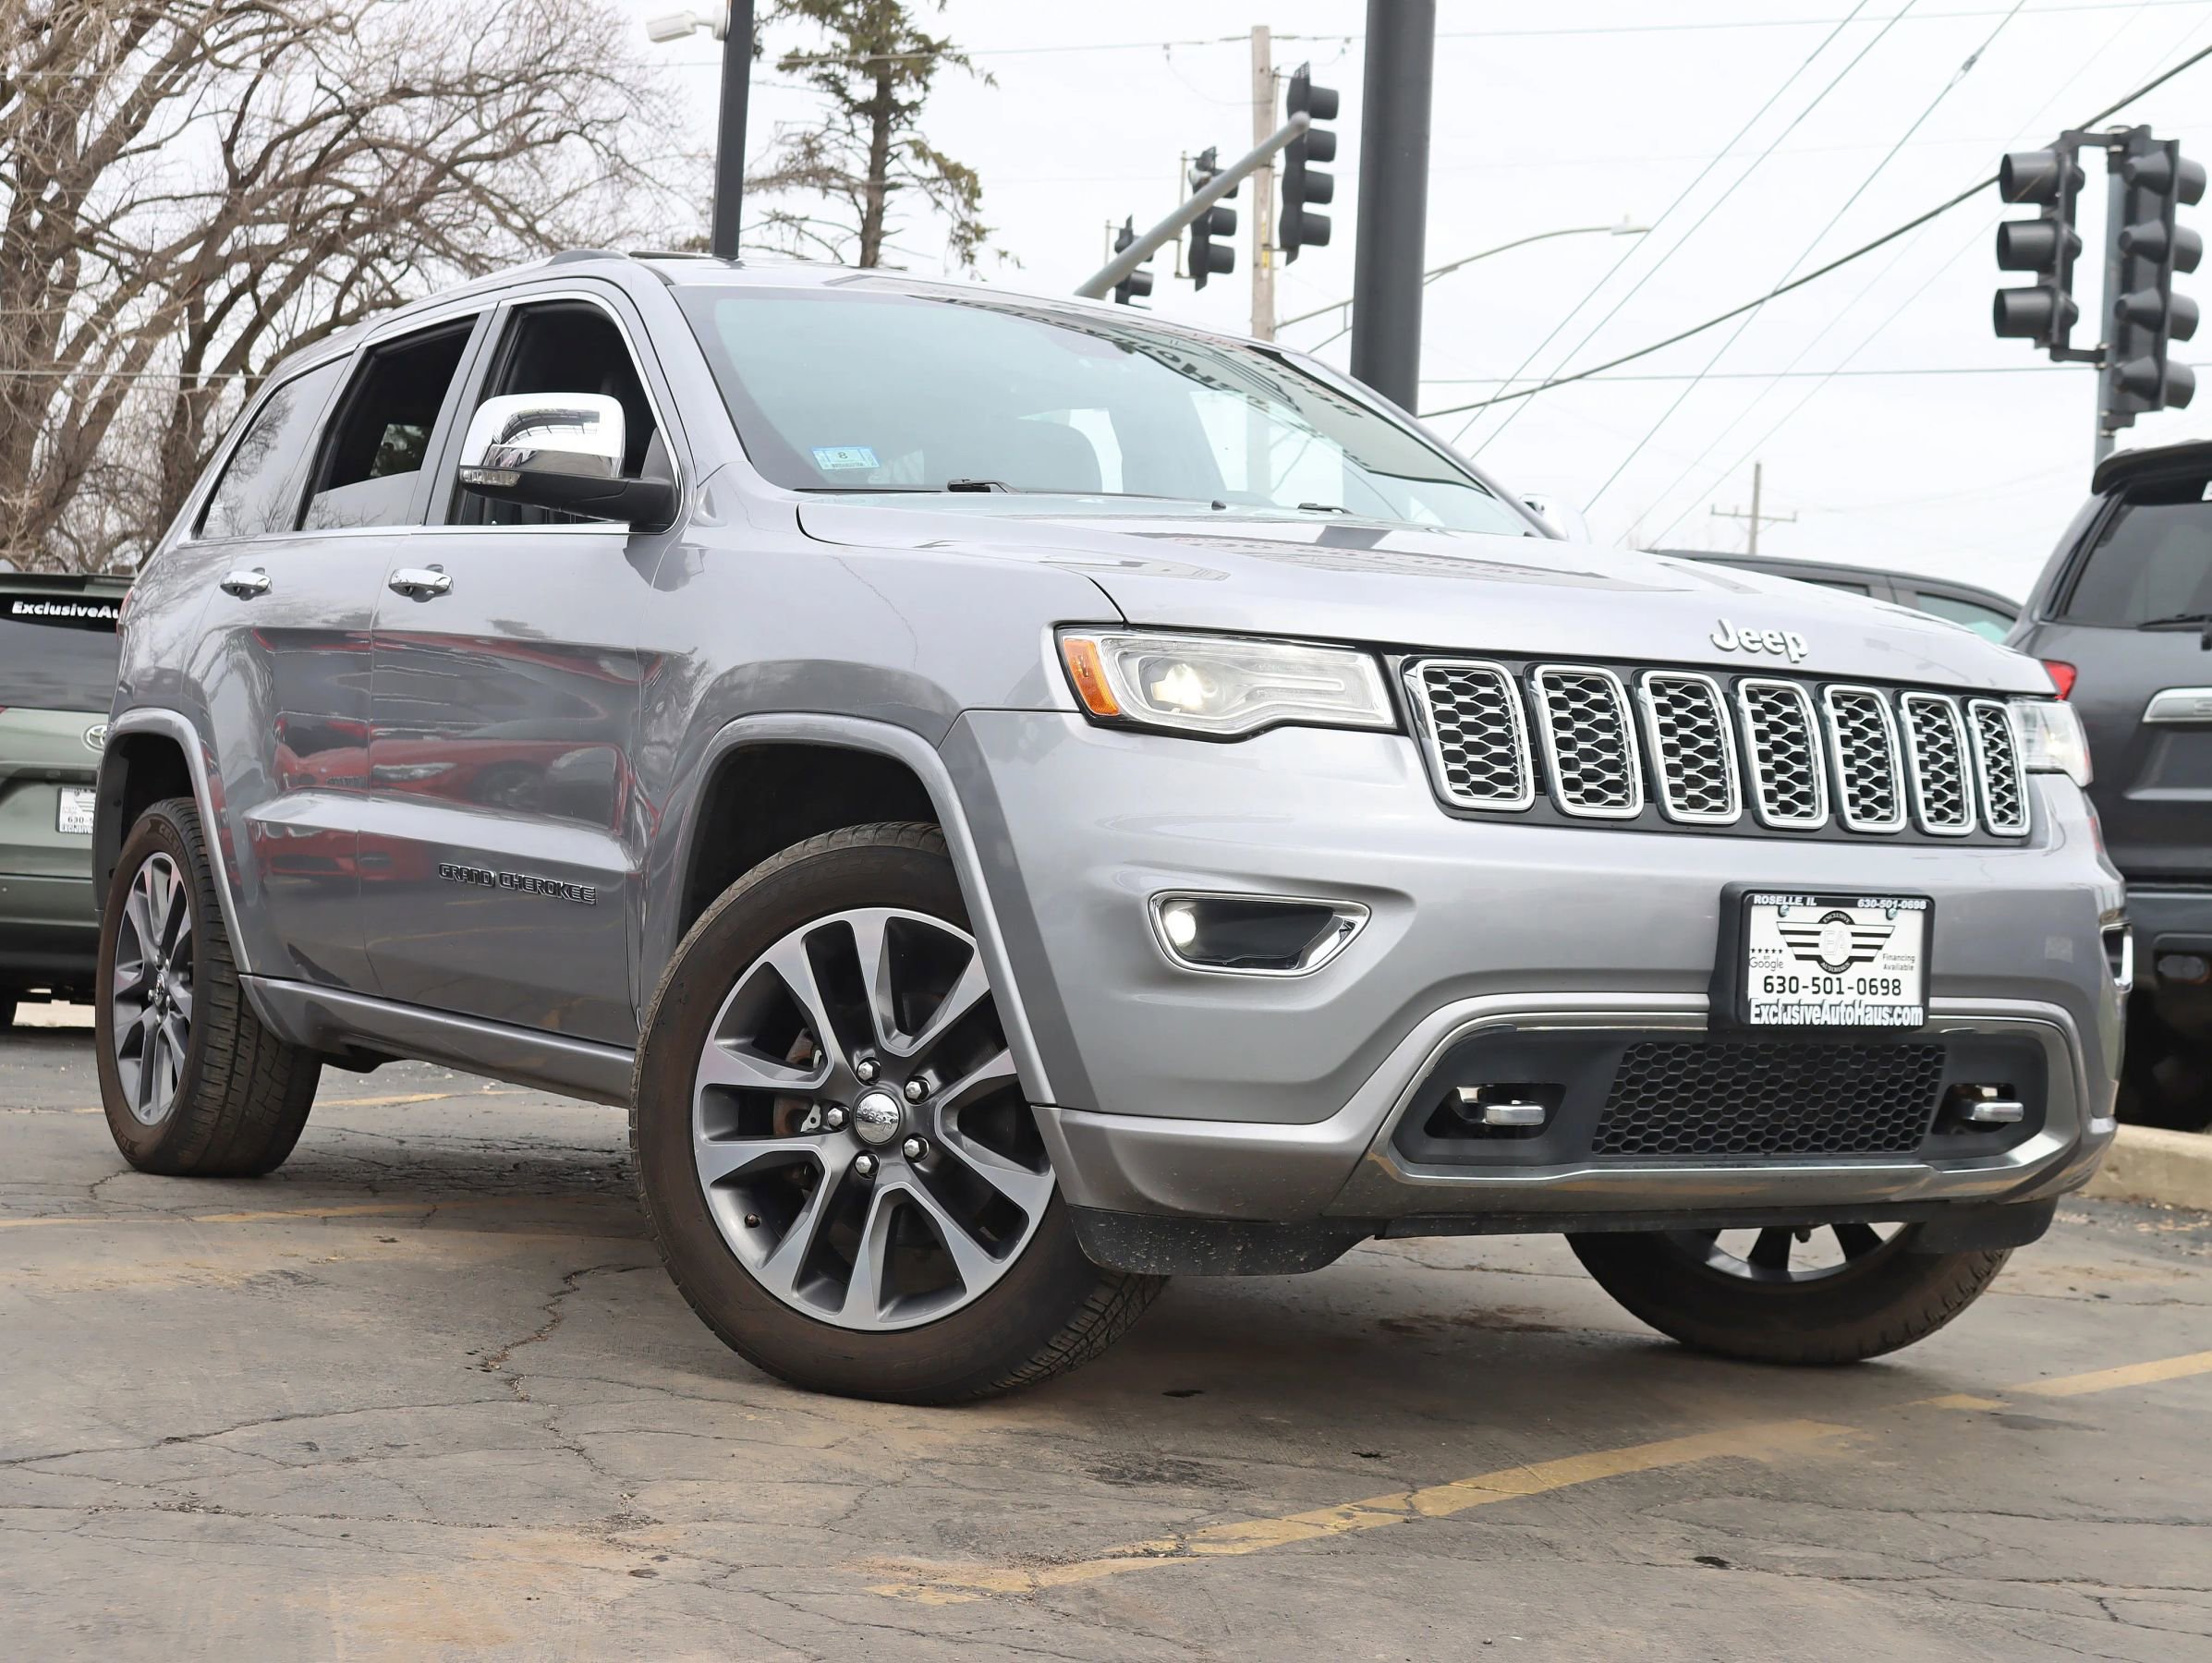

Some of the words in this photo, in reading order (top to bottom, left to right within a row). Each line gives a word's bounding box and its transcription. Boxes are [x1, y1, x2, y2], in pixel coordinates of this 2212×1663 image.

[1709, 618, 1809, 663] Jeep
[438, 862, 496, 887] GRAND
[499, 871, 597, 904] CHEROKEE
[1805, 896, 1817, 906] IL
[1857, 898, 1926, 910] 630-501-0698
[1750, 956, 1783, 971] Google
[1882, 953, 1915, 963] Financing
[1763, 976, 1902, 996] 630-501-0698
[1750, 1001, 1924, 1026] ExclusiveAutoHaus.com
